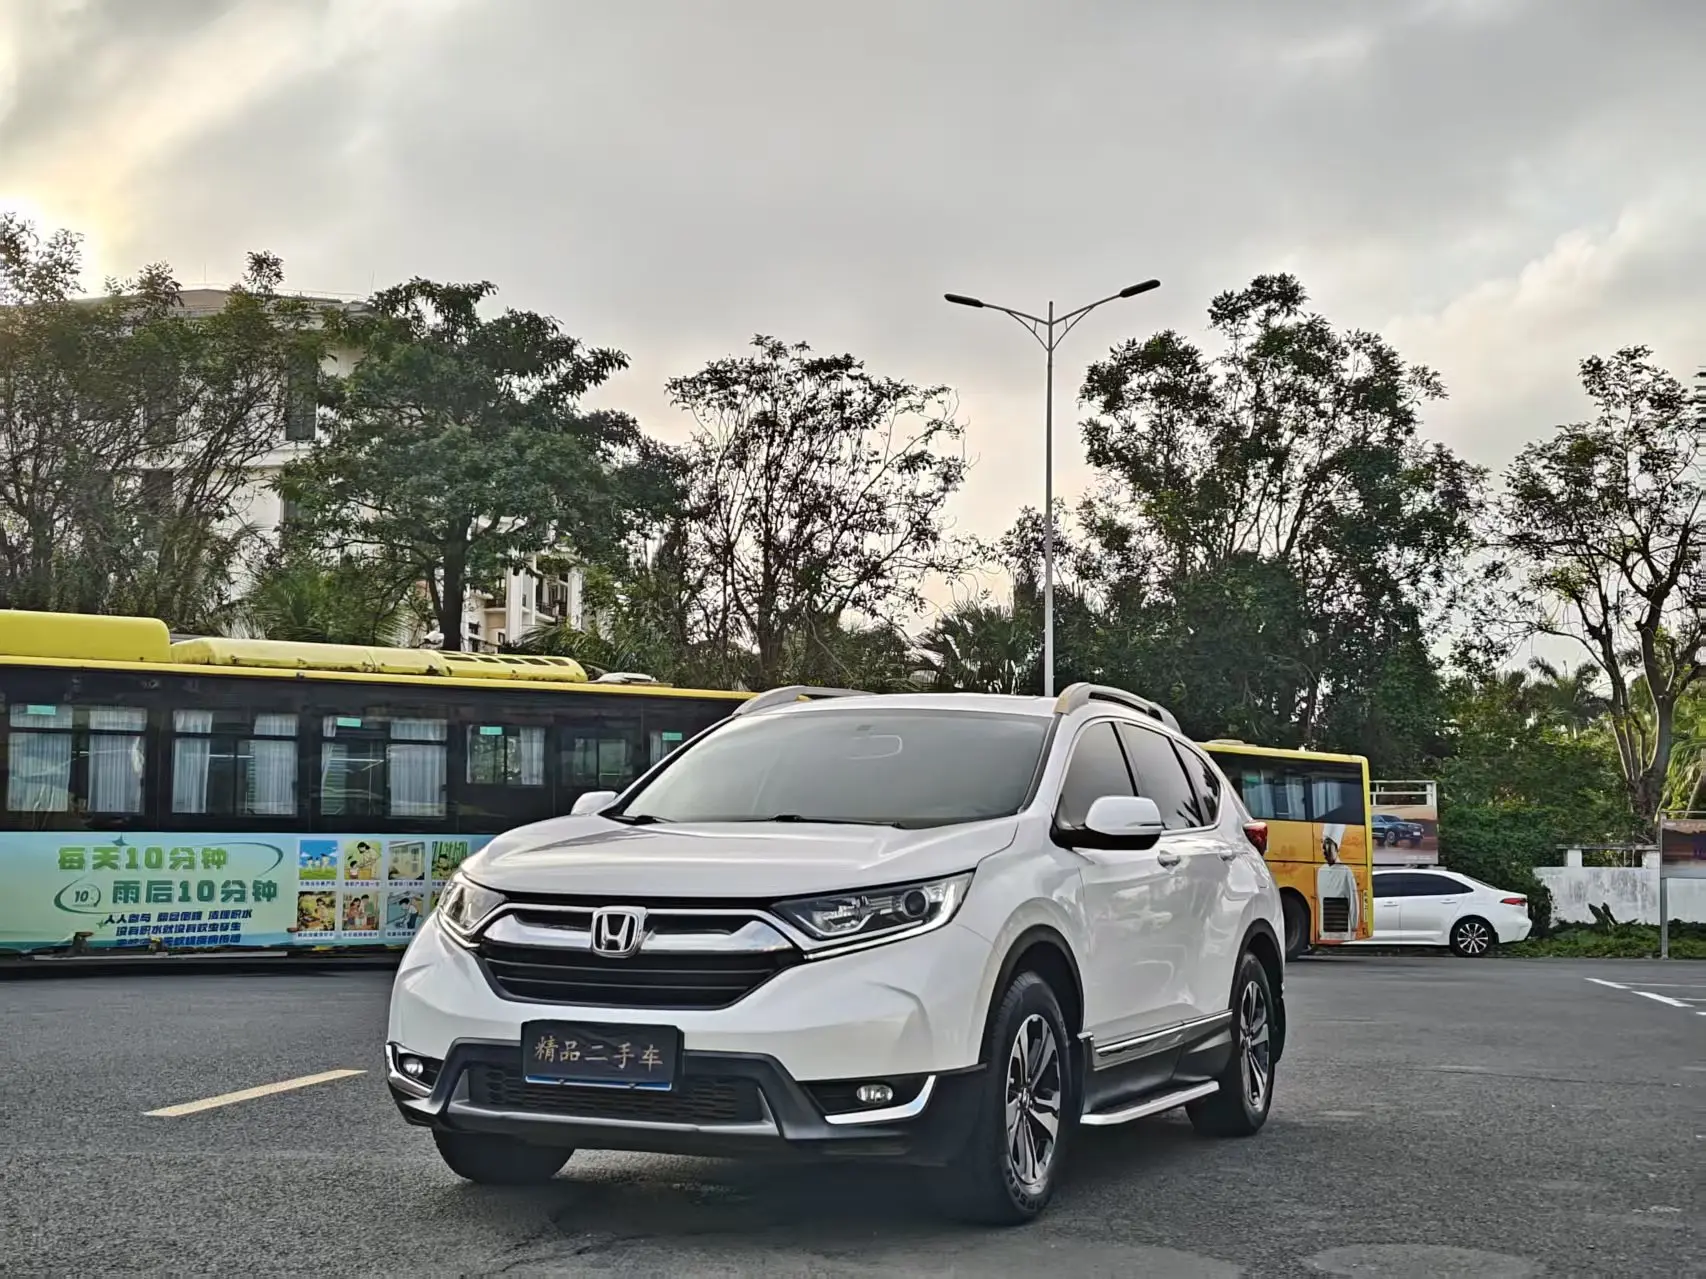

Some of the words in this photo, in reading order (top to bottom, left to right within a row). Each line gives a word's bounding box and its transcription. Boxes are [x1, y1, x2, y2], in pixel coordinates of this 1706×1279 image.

[58, 847, 228, 871] 每天10分钟
[75, 890, 89, 903] 10
[112, 880, 278, 904] 雨后10分钟
[104, 913, 152, 924] 人人参与
[534, 1036, 664, 1072] 精品二手车
